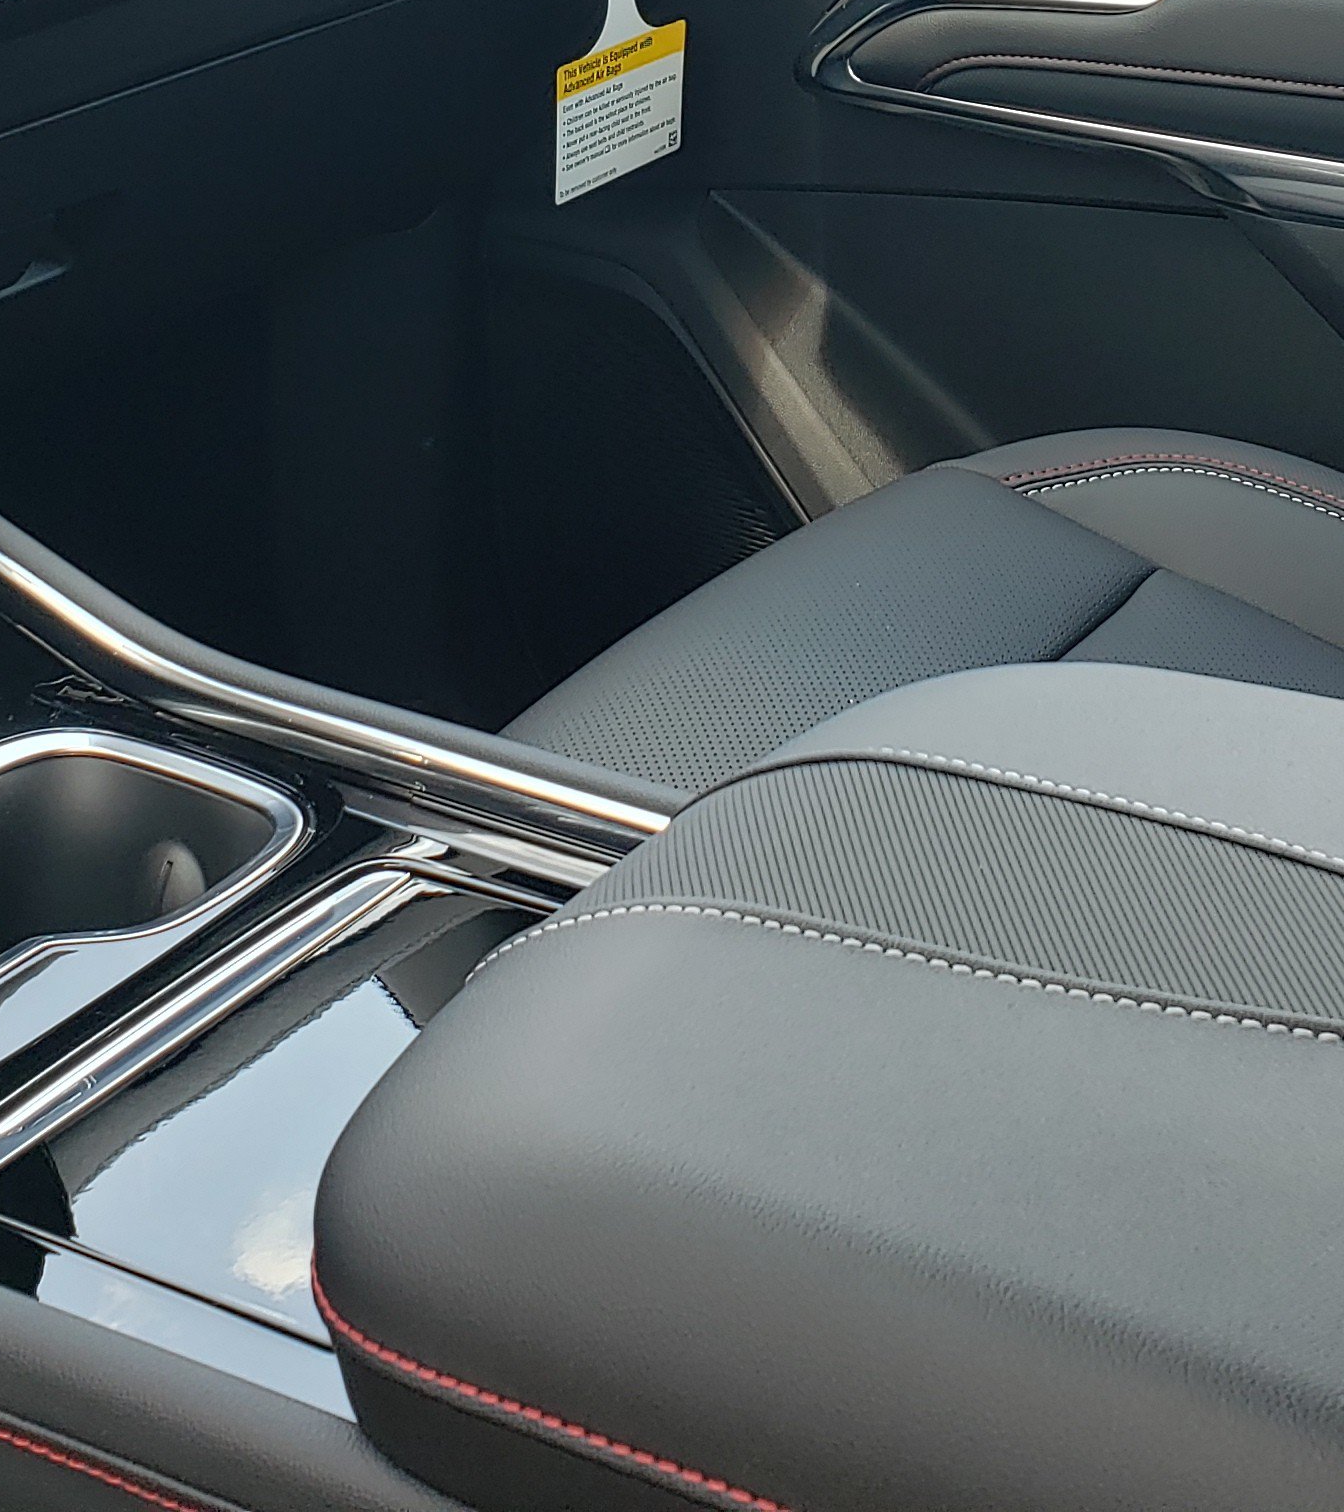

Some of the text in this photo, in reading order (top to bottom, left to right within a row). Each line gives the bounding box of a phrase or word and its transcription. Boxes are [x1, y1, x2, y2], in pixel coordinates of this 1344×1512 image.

[564, 68, 577, 81] This
[579, 58, 601, 74] Vehicle
[610, 42, 638, 62] Equipped
[564, 72, 594, 94] Advanced
[606, 63, 621, 76] Bags
